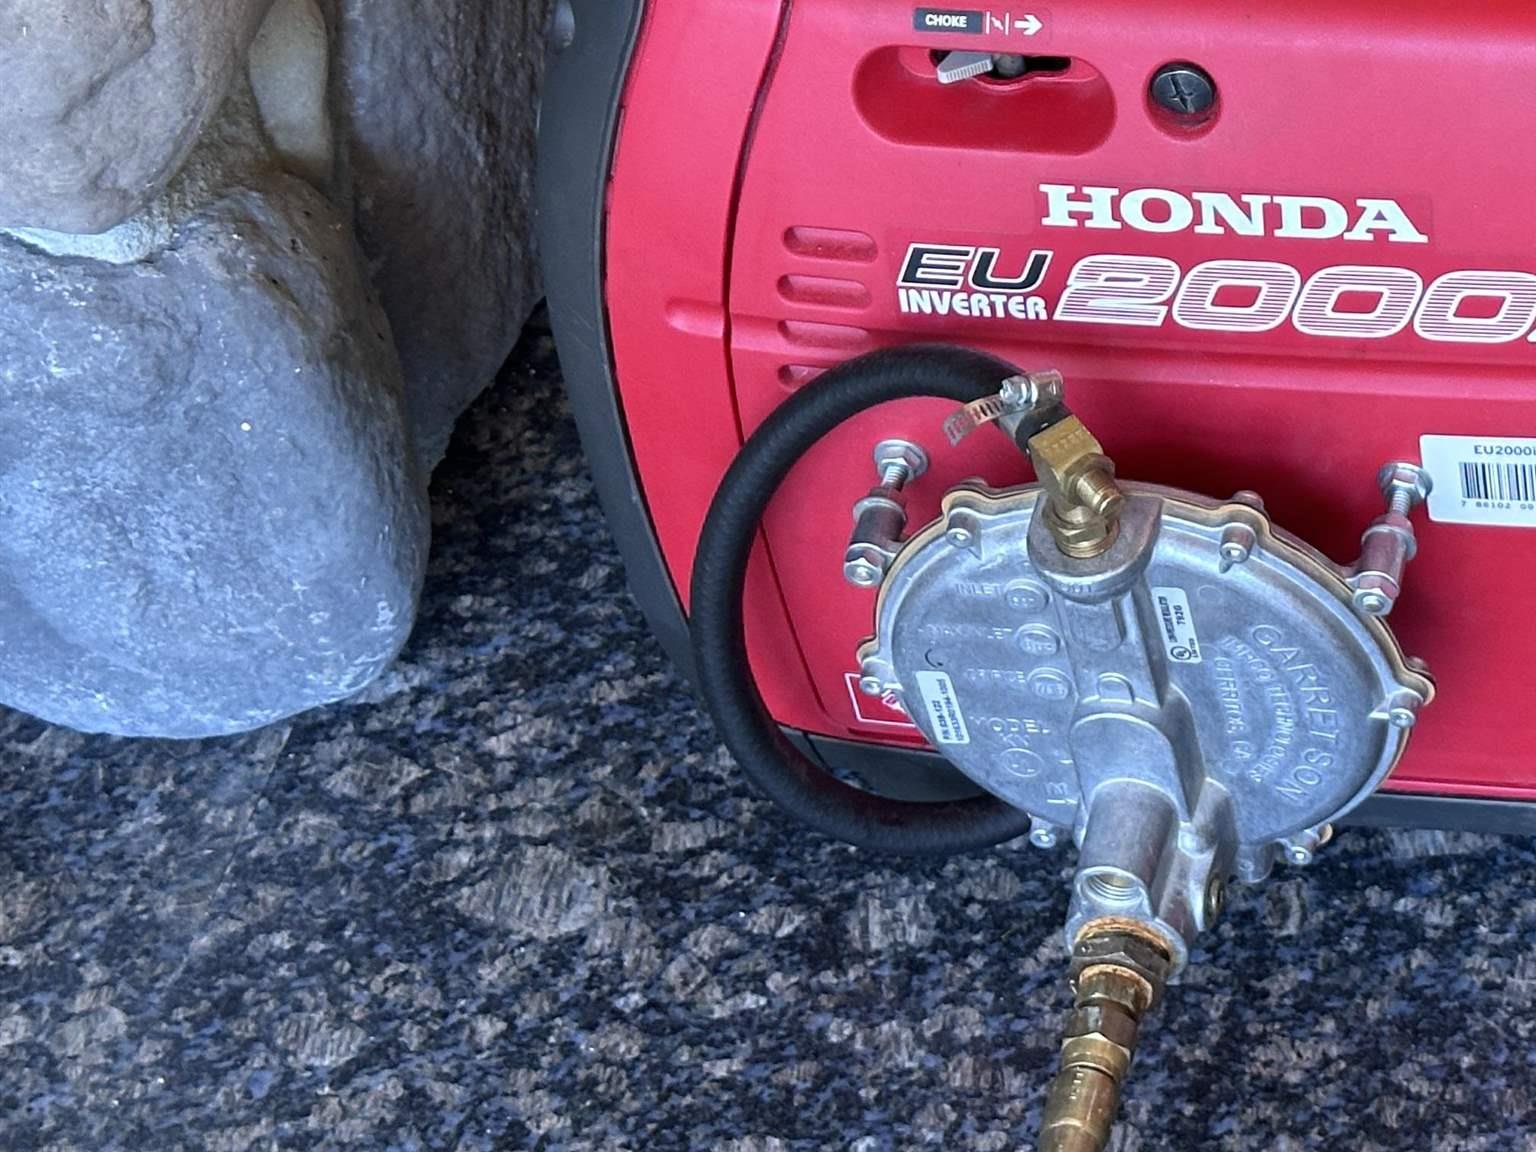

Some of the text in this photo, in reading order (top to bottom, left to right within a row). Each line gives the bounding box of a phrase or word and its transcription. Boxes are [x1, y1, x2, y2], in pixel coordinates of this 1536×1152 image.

[925, 14, 968, 28] CHOKE
[1038, 183, 1429, 244] HONDA
[896, 242, 1054, 294] EU
[898, 287, 1049, 322] INVERTER
[1251, 623, 1339, 801] GARRETSON
